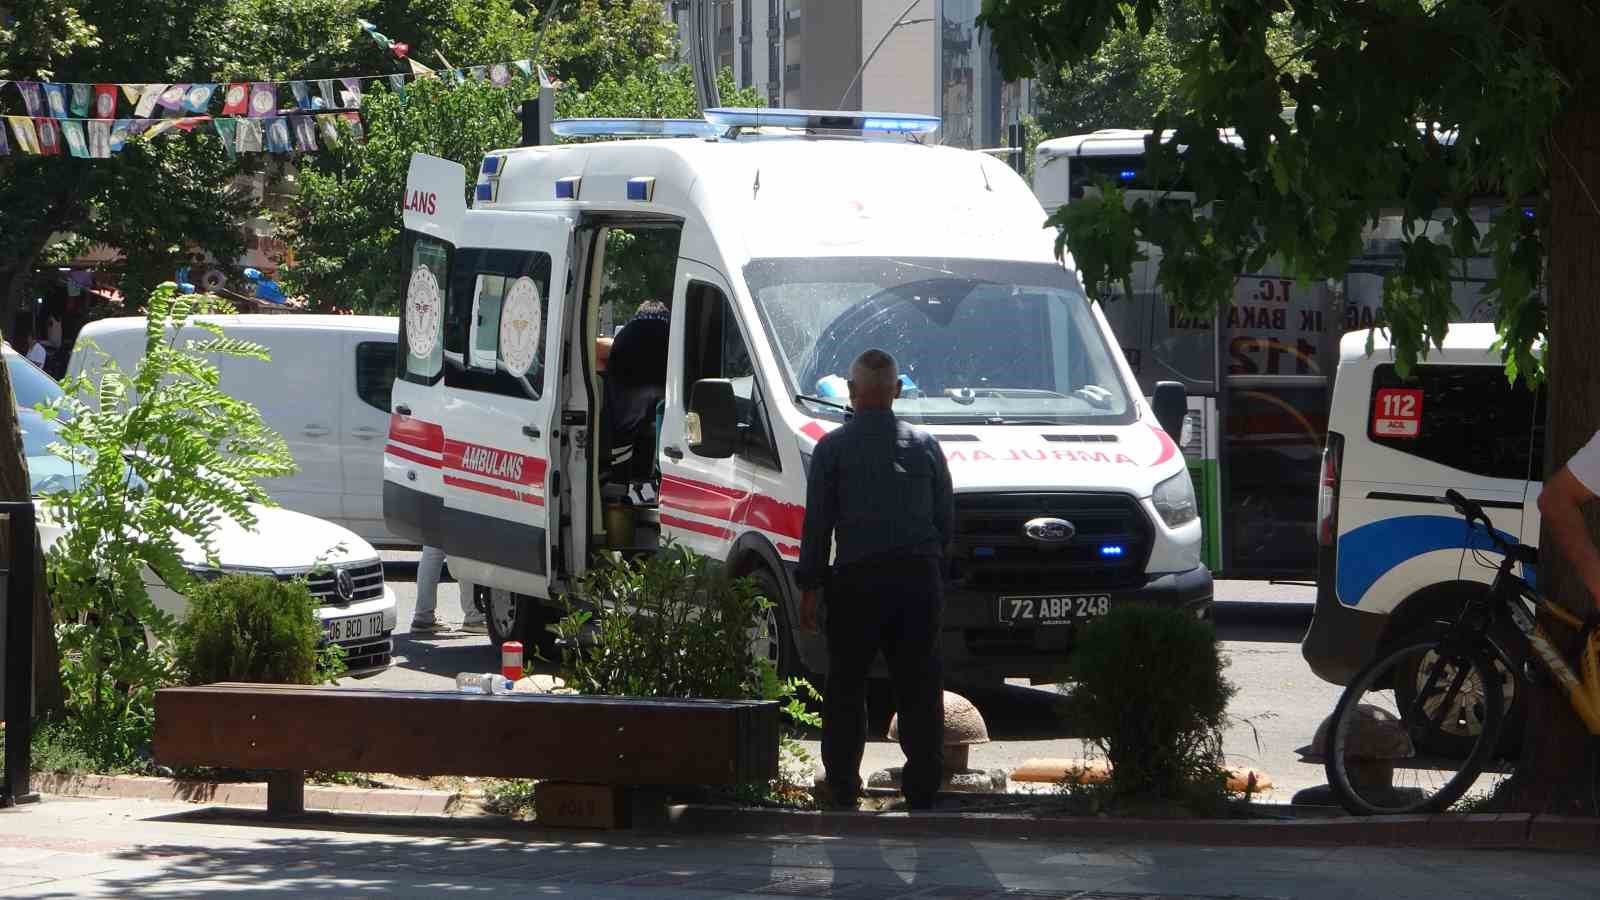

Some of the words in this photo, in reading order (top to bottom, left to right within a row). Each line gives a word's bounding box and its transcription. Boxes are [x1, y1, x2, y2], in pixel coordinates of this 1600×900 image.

[402, 190, 436, 216] LANS
[1383, 394, 1416, 417] 112
[462, 446, 523, 480] AMBULANS
[1011, 599, 1034, 618] 72
[1039, 598, 1072, 618] ABP
[1076, 597, 1109, 617] 248
[329, 621, 341, 640] 06
[346, 618, 362, 638] BCD
[369, 614, 381, 635] 112
